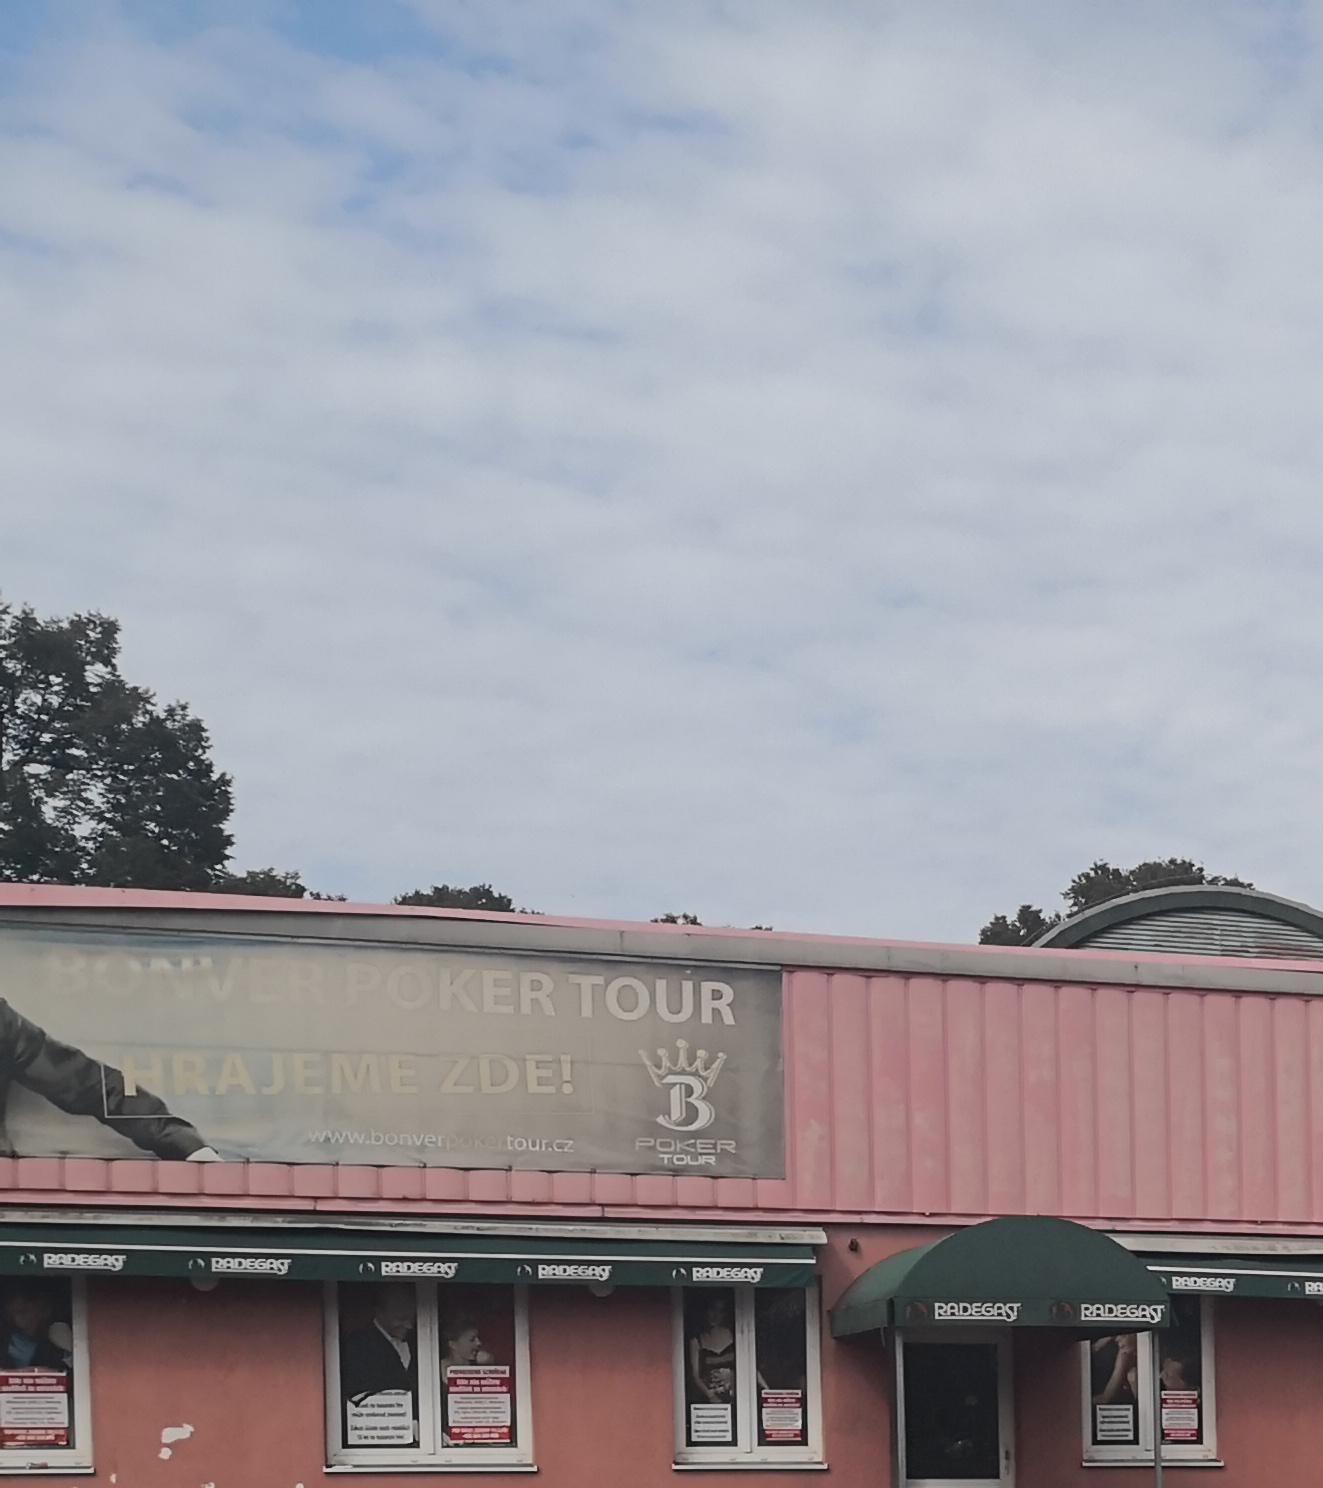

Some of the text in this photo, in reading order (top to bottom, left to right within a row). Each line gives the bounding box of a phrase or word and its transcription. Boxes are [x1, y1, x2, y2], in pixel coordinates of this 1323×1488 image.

[346, 961, 556, 1017] POKER
[568, 974, 736, 1025] TOUR
[121, 1053, 575, 1097] HRAJEME ZDE!
[635, 1138, 737, 1154] POKER
[659, 1154, 717, 1166] TOUR
[43, 1253, 127, 1271] RADEGAST
[211, 1257, 292, 1275] RADEGAST
[381, 1261, 458, 1279] RADEGAST
[538, 1264, 612, 1281] RADEGAST
[692, 1267, 764, 1283] RADEGAST
[1172, 1276, 1236, 1292] RADEGAST
[934, 1302, 1021, 1322] RADEGAST
[1080, 1303, 1166, 1323] RADEGAST
